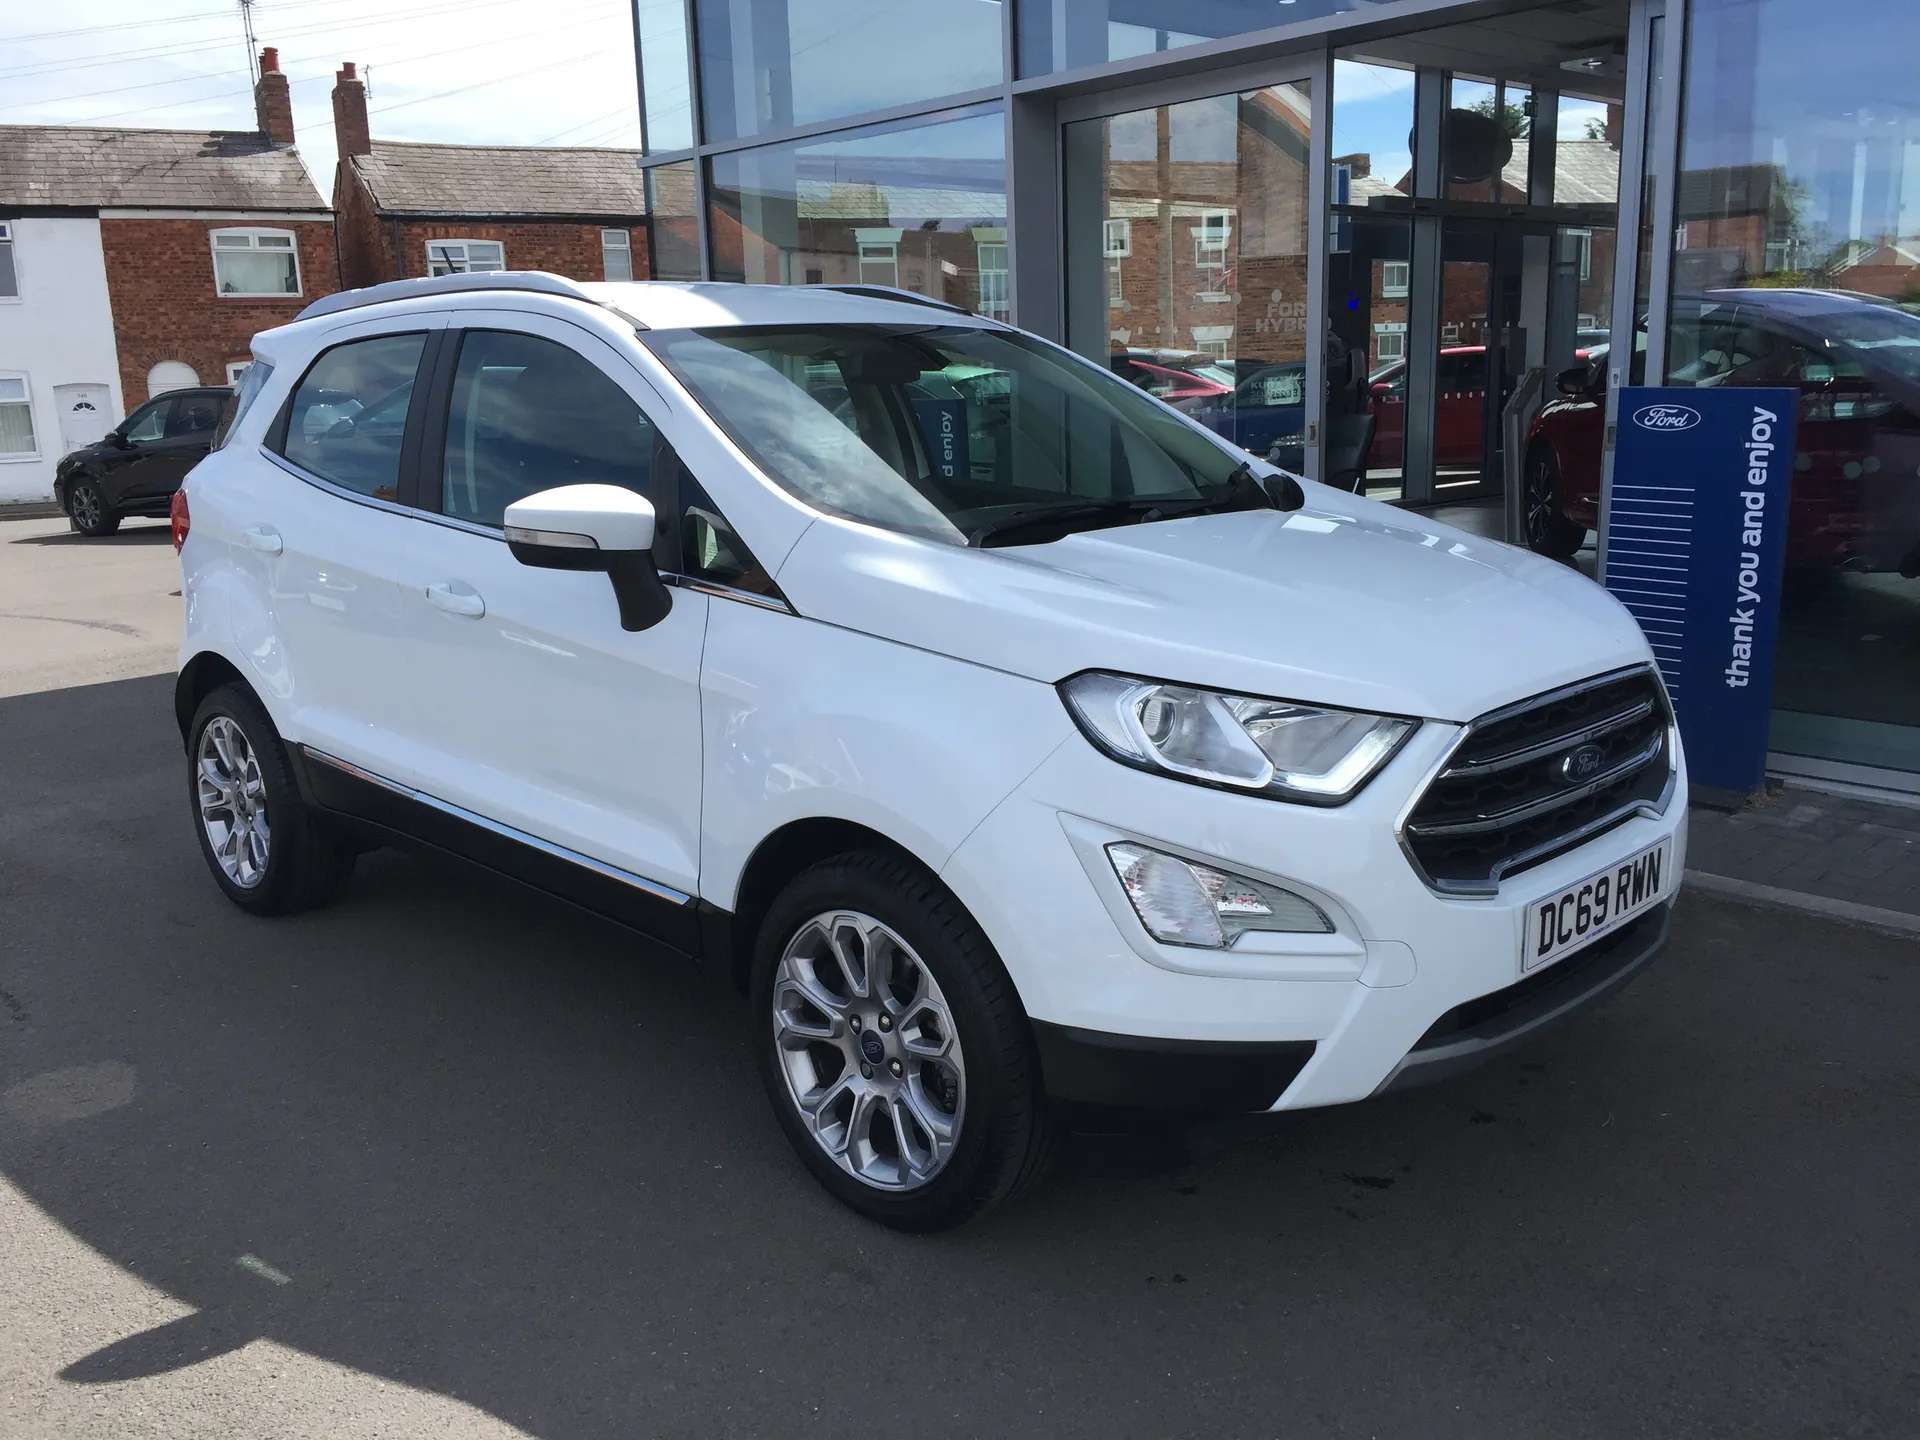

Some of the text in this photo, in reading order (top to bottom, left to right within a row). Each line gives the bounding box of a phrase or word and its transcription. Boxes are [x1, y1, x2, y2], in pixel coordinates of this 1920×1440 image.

[940, 410, 954, 461] enjoy
[1642, 406, 1690, 428] Ford
[1725, 406, 1778, 688] thank you and enjoy
[1576, 752, 1601, 776] Ford
[1538, 847, 1663, 958] DC69 RWN
